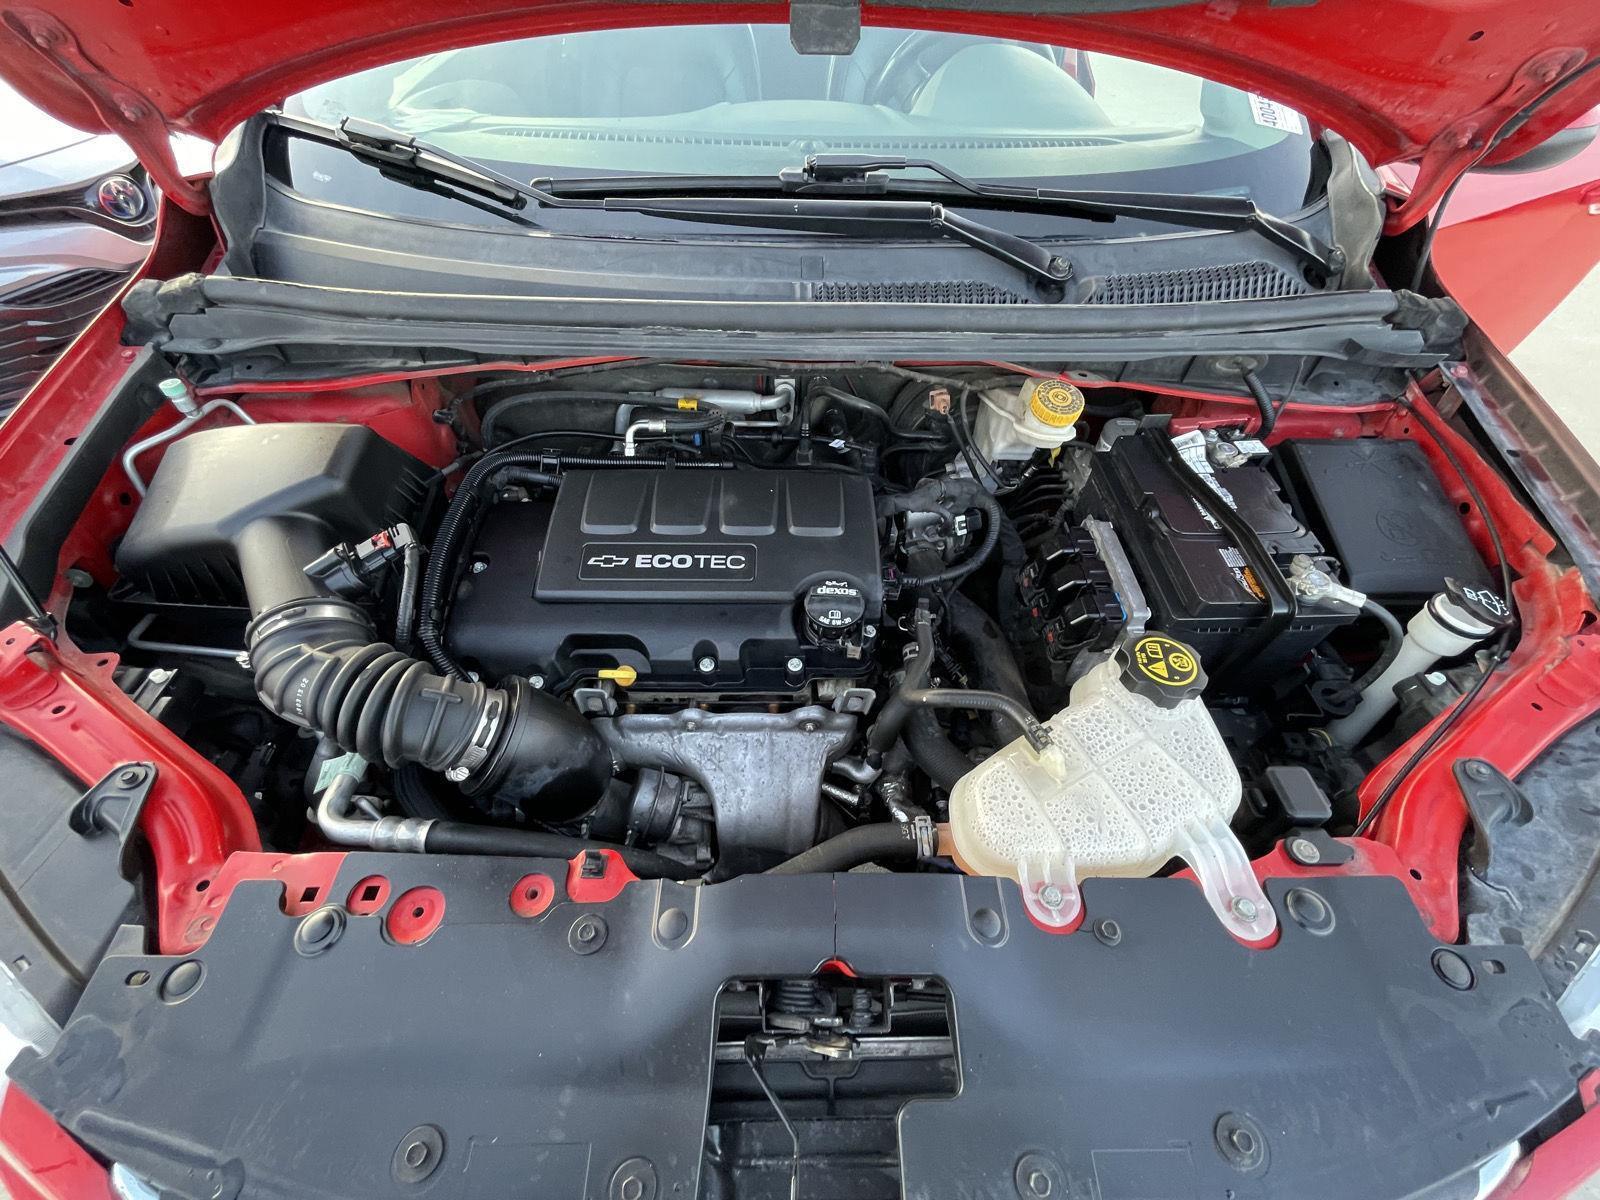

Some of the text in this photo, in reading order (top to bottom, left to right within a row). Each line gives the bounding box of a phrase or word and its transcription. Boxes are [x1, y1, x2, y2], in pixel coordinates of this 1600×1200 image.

[634, 553, 746, 570] ECOTEC
[816, 585, 857, 596] dexos
[818, 615, 830, 625] SAE
